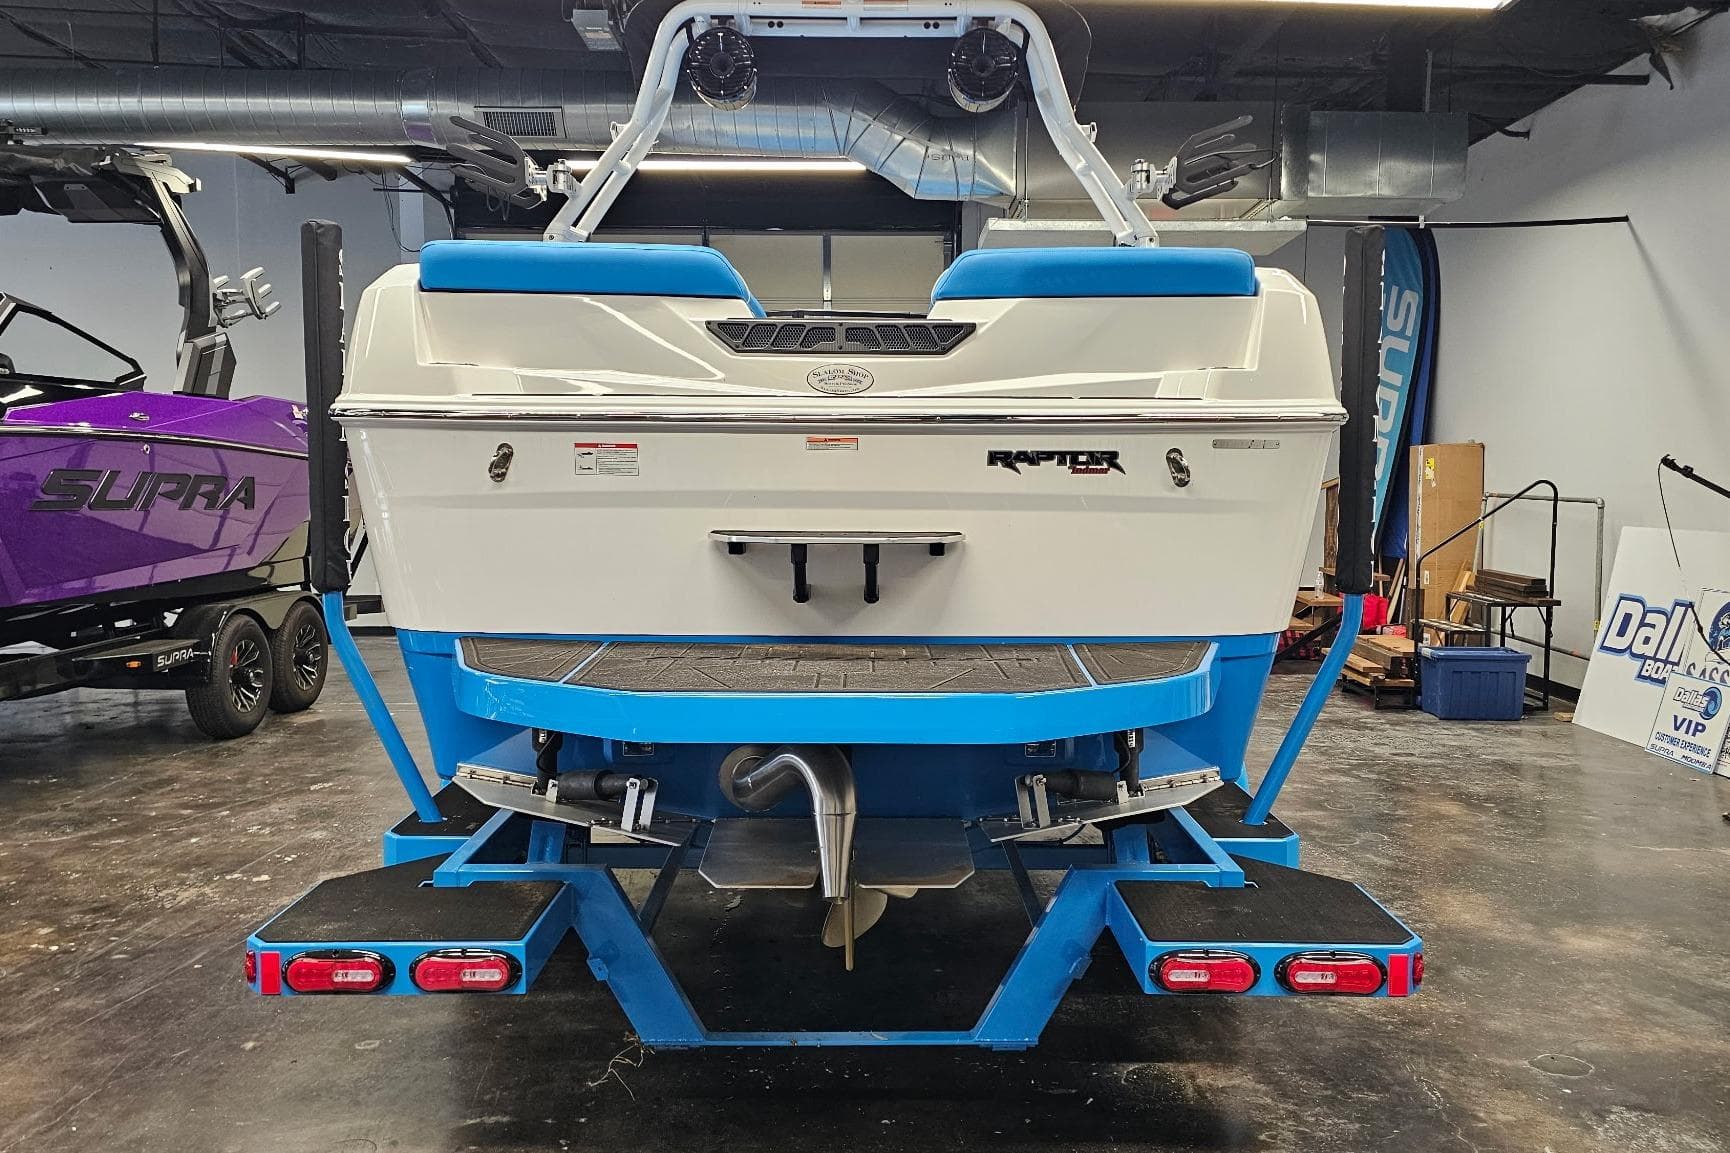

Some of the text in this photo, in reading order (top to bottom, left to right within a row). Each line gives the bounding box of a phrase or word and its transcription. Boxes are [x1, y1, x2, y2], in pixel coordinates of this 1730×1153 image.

[987, 450, 1126, 475] RAPTOR
[27, 468, 256, 512] SUPRA
[157, 647, 194, 667] SUPRA
[1673, 686, 1710, 709] Dallas
[1673, 714, 1707, 738] VIP
[1649, 743, 1712, 770] SUPRA MOOMBA
[1655, 731, 1712, 758] CUSTOMER EXPERIENCE
